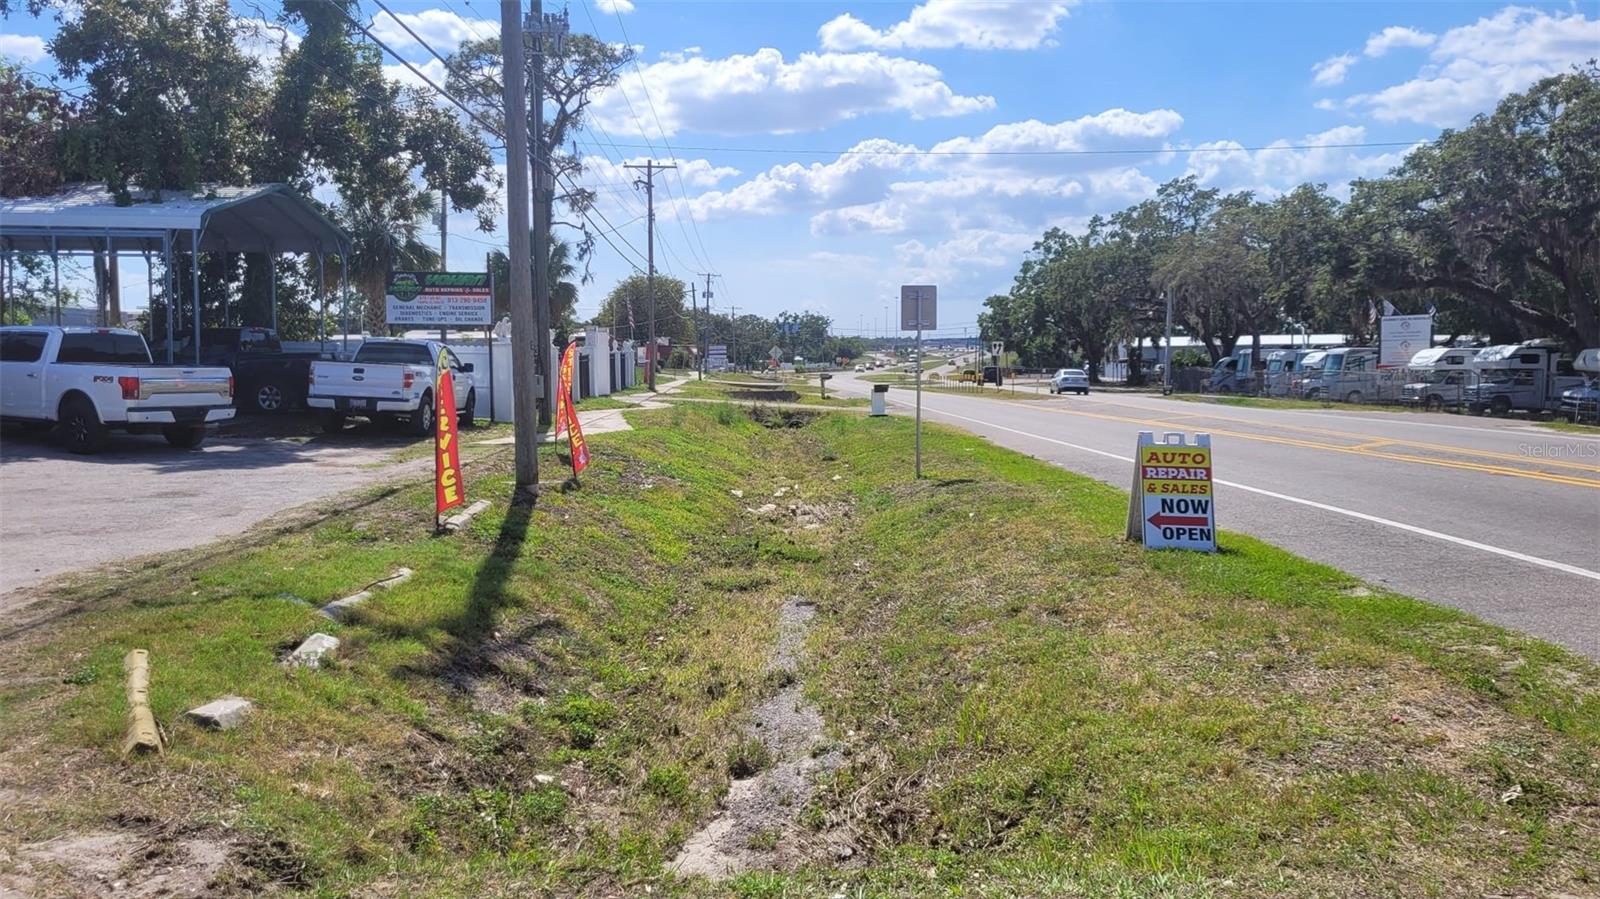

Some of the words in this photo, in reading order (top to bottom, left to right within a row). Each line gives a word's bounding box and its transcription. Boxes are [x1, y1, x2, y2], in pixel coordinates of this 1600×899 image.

[94, 376, 114, 384] FX4
[1146, 451, 1206, 465] AUTO
[1145, 467, 1208, 480] REPAIR
[1147, 483, 1157, 493] &
[1161, 483, 1208, 495] SALES
[1161, 498, 1209, 514] NOW
[1162, 526, 1211, 541] OPEN
